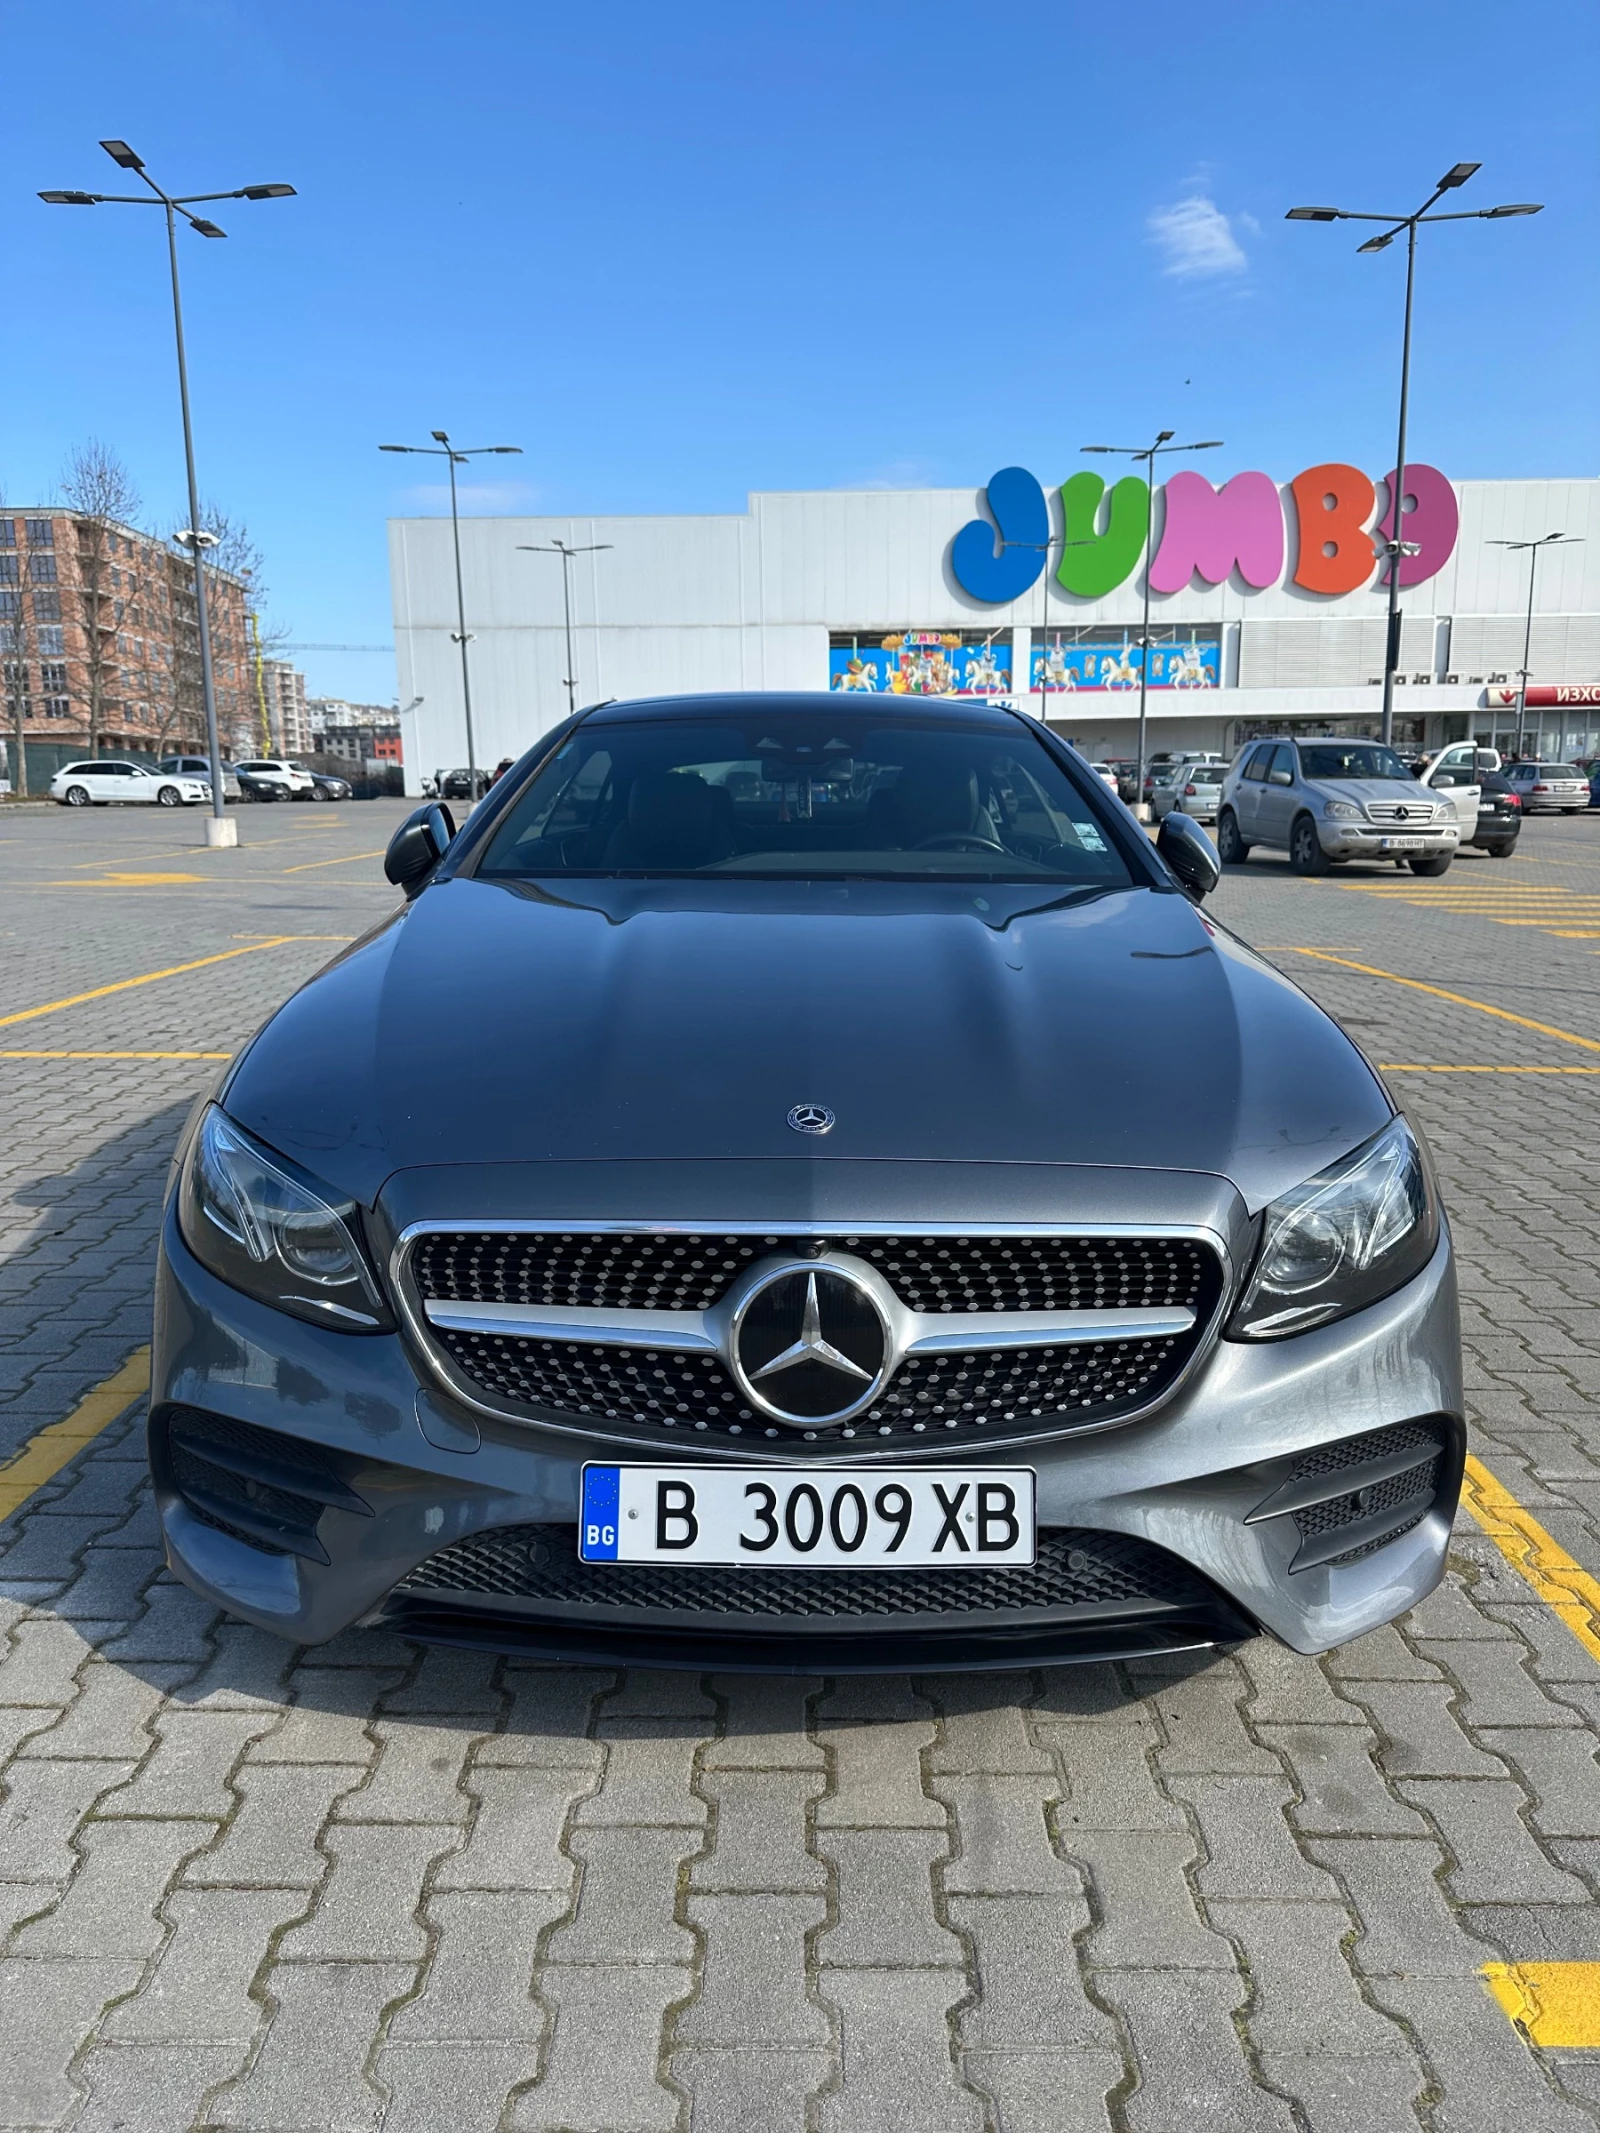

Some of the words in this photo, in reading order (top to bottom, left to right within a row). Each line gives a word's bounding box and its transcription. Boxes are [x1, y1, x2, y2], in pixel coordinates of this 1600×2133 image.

[952, 463, 1459, 603] JUMBO
[904, 632, 941, 645] JUMBO
[586, 1525, 615, 1546] BG
[656, 1480, 699, 1549] B
[739, 1483, 913, 1553] 3009
[931, 1483, 1020, 1553] XB
